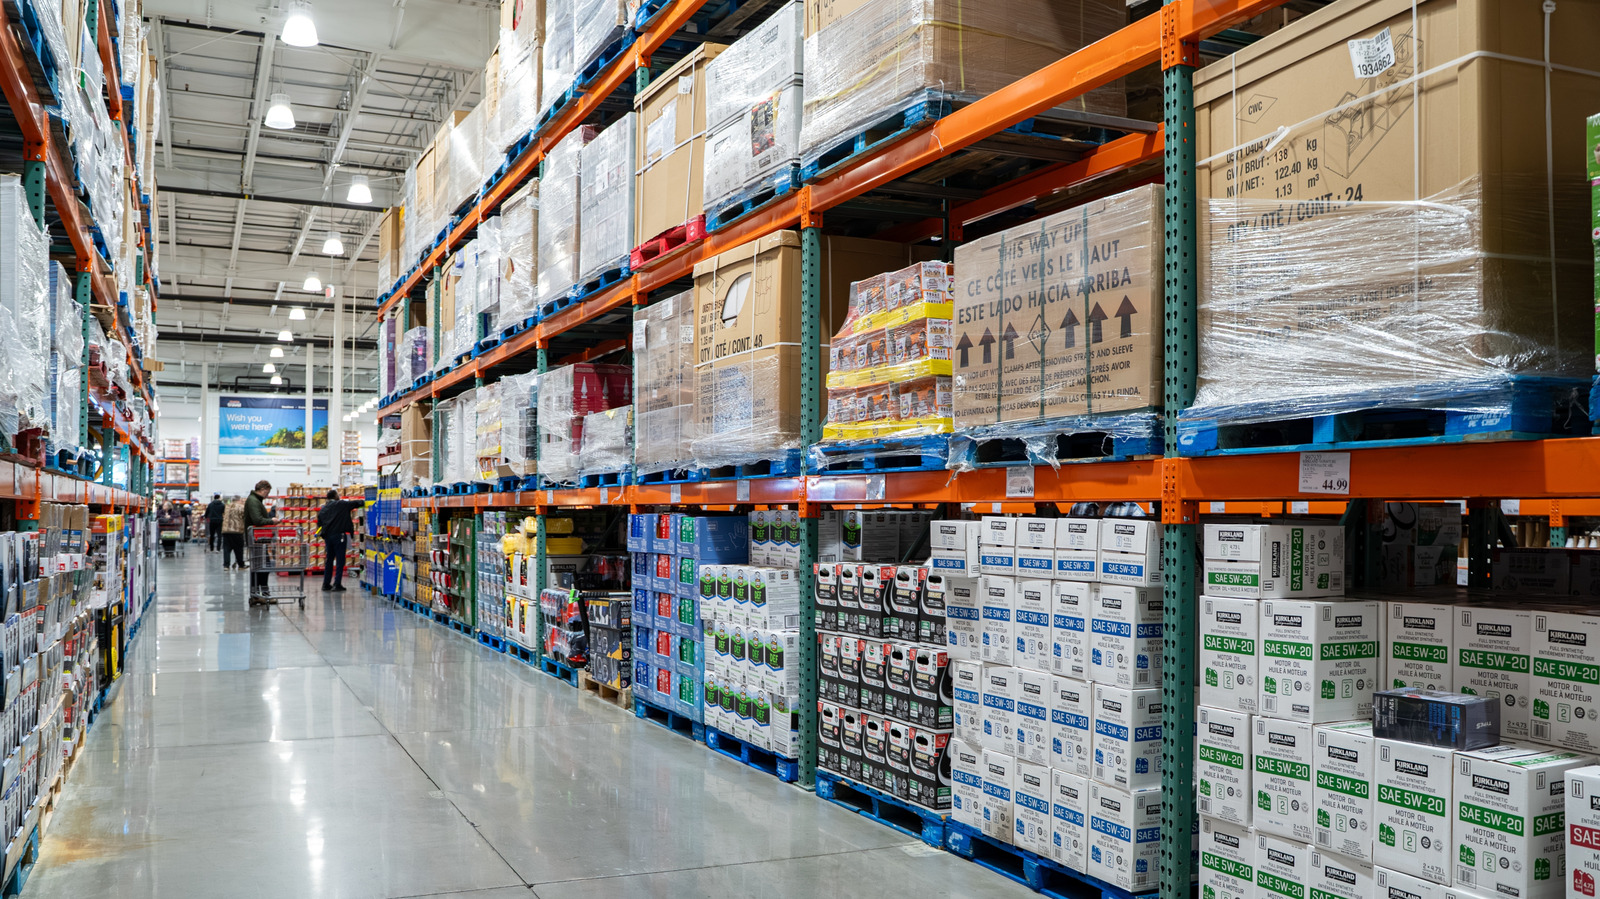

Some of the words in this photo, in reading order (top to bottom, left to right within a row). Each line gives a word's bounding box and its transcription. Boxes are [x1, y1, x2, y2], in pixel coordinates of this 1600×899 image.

[1358, 54, 1391, 75] 1934862
[1248, 101, 1263, 116] CWC
[1306, 138, 1317, 152] kg
[1274, 149, 1288, 163] 138
[1275, 161, 1301, 180] 122.40
[1307, 158, 1318, 170] kg
[1276, 183, 1292, 199] 1.13
[1346, 184, 1363, 207] 24
[1030, 231, 1057, 254] WAY
[1064, 223, 1082, 244] UP
[968, 280, 981, 297] CE
[1022, 258, 1053, 281] VERS
[1060, 253, 1072, 272] LE
[959, 304, 984, 324] ESTE
[990, 294, 1022, 317] LADO
[1029, 283, 1070, 308] HACIA
[1077, 267, 1132, 297] ARRIBA
[701, 348, 710, 362] QTY
[716, 340, 727, 358] QTÉ
[754, 334, 762, 348] 48
[1004, 365, 1024, 373] CLAMPS
[1097, 348, 1110, 358] AND
[1112, 344, 1133, 355] SLEEVE
[1092, 362, 1109, 372] APRÈS
[1111, 361, 1130, 371] AVOIR
[1077, 374, 1111, 386] MACHON.
[1069, 395, 1079, 403] LAS
[1103, 390, 1106, 398] Y
[248, 415, 262, 423] you
[252, 423, 273, 431] here?
[1322, 480, 1348, 490] 44.99
[1293, 530, 1301, 570] 5W-20
[1109, 564, 1119, 572] SAE
[1120, 565, 1138, 574] 5W-30
[1215, 574, 1227, 582] SAE
[1229, 575, 1251, 584] 5W-20
[1336, 616, 1361, 624] KIRKLAND
[1093, 621, 1107, 632] SAE
[1107, 623, 1130, 635] 5W-30
[1478, 624, 1510, 632] KIRKLAND
[1550, 631, 1584, 640] KIRKLAND
[1206, 637, 1221, 648] SAE
[1224, 639, 1252, 652] 5W-20
[1266, 643, 1281, 654] SAE
[1283, 644, 1311, 657] 5W-20
[1323, 645, 1340, 657] SAE
[1343, 644, 1373, 656] 5W-20
[1394, 645, 1411, 656] SAE
[1414, 647, 1446, 660] 5W-20
[1462, 651, 1483, 665] SAE
[1486, 653, 1527, 670] 5W-20
[1478, 671, 1498, 680] MOTOR
[1535, 661, 1556, 675] SAE
[1558, 664, 1598, 680] 5W-20
[1471, 679, 1487, 687] HUILE
[1494, 681, 1518, 690] MOTEUR
[1548, 681, 1570, 691] MOTOR
[1573, 684, 1583, 692] OIL
[1540, 688, 1557, 698] HUILE
[1565, 692, 1592, 703] MOTEUR
[1210, 723, 1233, 733] KIRKLAND
[1270, 733, 1295, 743] KIRKLAND
[1201, 747, 1214, 759] SAE
[1216, 751, 1242, 766] 5W-20
[1329, 747, 1357, 758] KIRKLAND
[1258, 758, 1275, 771] SAE
[1276, 762, 1308, 778] 5W-20
[1396, 761, 1427, 772] KIRKLAND
[1318, 774, 1334, 786] SAE
[1336, 778, 1367, 795] 5W-20
[1474, 775, 1508, 789] KIRKLAND
[1380, 787, 1401, 803] SAE
[1404, 792, 1443, 813] 5W-20
[1395, 809, 1415, 819] MOTOR
[1417, 814, 1426, 822] OIL
[1461, 806, 1481, 820] SAE
[1484, 812, 1522, 832] 5W-20
[1092, 818, 1105, 830] SAE
[1106, 823, 1129, 839] 5W-30
[1388, 816, 1404, 826] HUILE
[1410, 821, 1434, 832] MOTEUR
[1536, 815, 1557, 832] SAE
[1215, 833, 1239, 845] KIRKLAND
[1574, 828, 1600, 845] SAE
[1268, 850, 1294, 863] KIRKLAND
[1203, 854, 1220, 868] SAE
[1221, 859, 1251, 878] 5W-20
[1326, 867, 1355, 882] KIRKLAND
[1258, 872, 1273, 887] SAE
[1275, 877, 1303, 897] 5W-20
